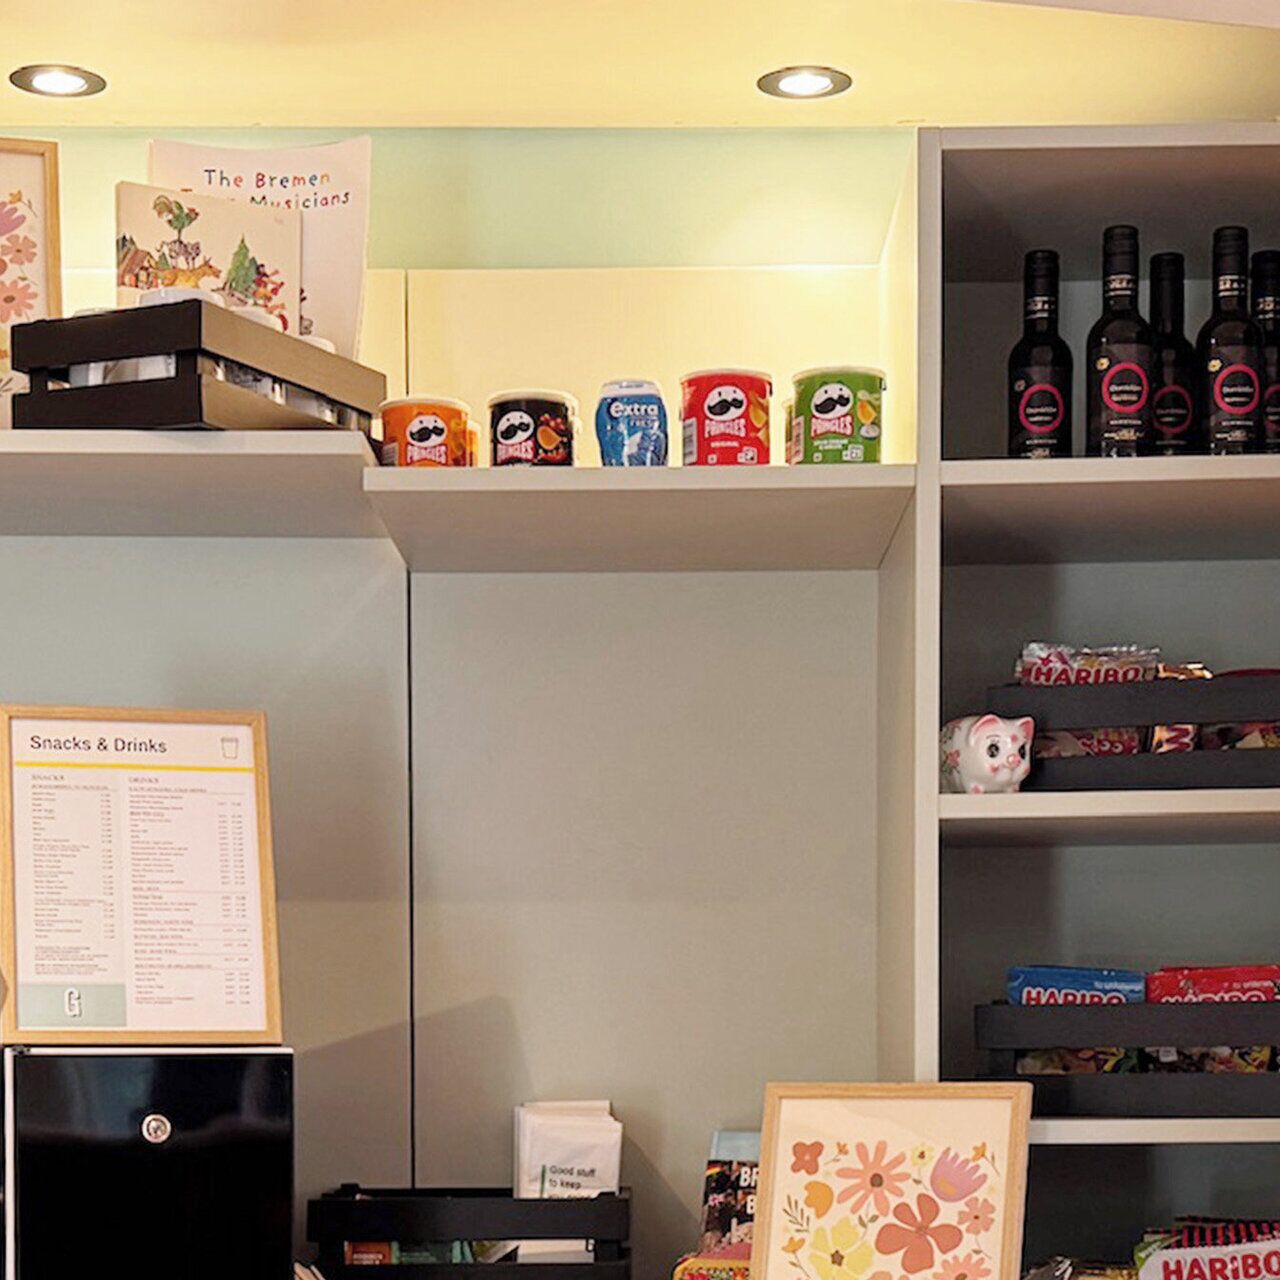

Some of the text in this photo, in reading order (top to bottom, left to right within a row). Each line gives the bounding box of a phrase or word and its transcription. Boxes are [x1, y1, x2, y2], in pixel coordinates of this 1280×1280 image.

[204, 169, 331, 189] The Bremen
[610, 401, 658, 418] extra
[1031, 665, 1143, 686] HARIBO
[29, 734, 168, 753] Snacks & Drinks
[548, 1165, 596, 1178] Good stuff
[560, 1180, 582, 1190] keep
